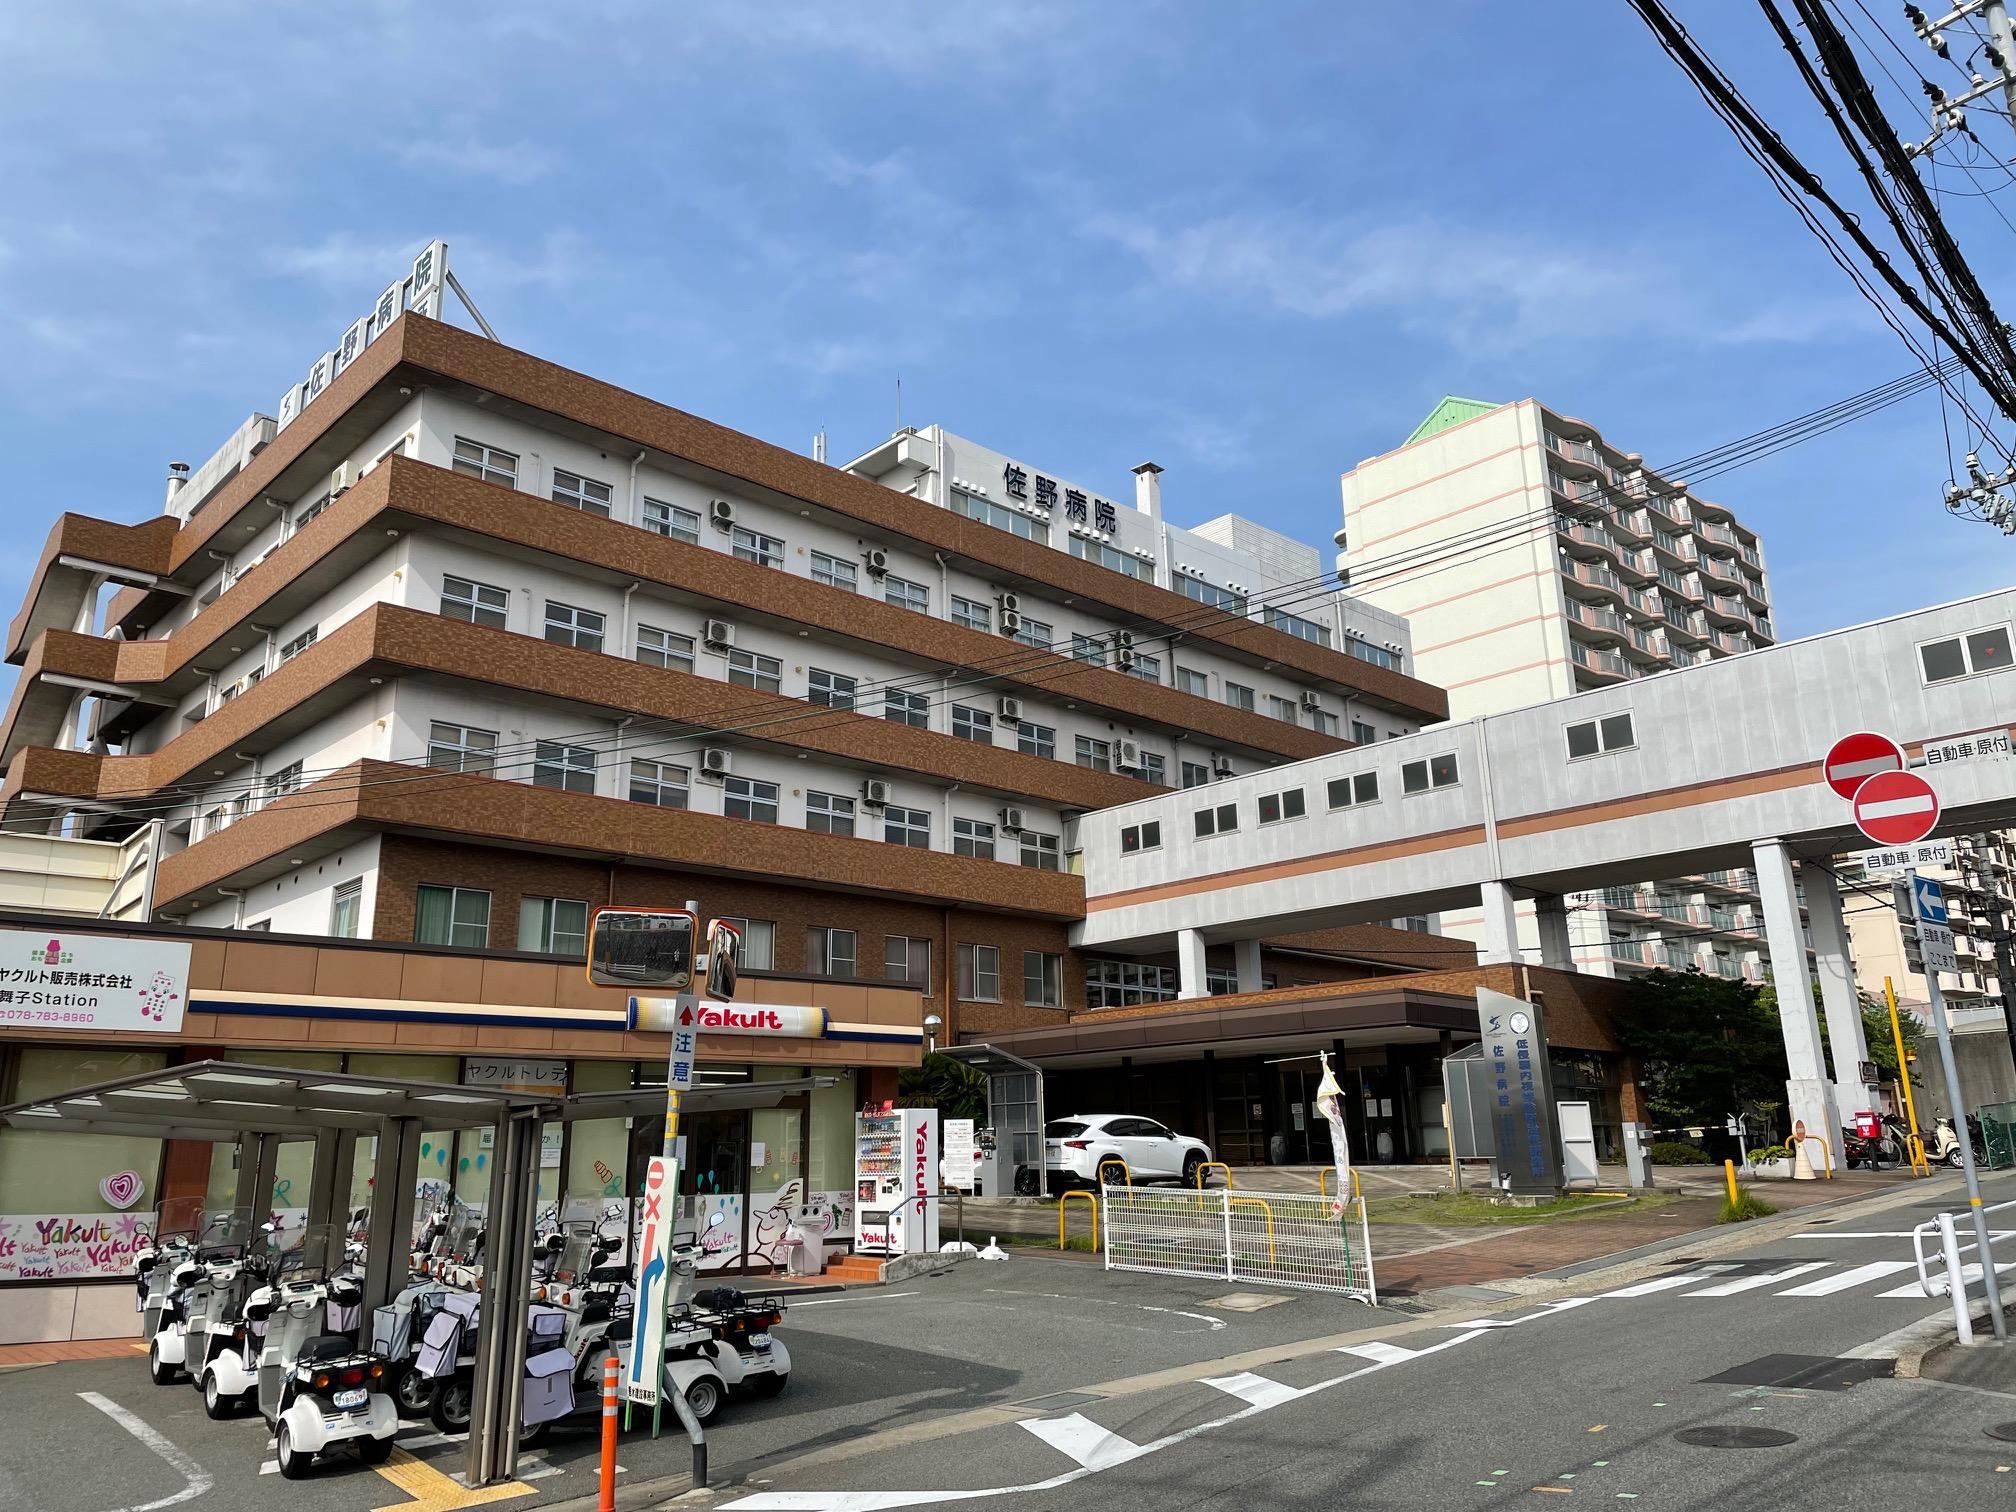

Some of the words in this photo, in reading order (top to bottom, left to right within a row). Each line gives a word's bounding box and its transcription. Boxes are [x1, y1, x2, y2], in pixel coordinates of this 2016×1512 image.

[310, 249, 433, 397] 佐野病院
[1003, 462, 1116, 534] 佐野病院
[1930, 952, 1955, 968] ここまで
[671, 1032, 693, 1083] 注意
[914, 1120, 929, 1215] Yakult
[36, 1218, 112, 1245] Yakult
[54, 1247, 81, 1259] Yakult
[87, 1234, 149, 1267] Yakult
[19, 1266, 55, 1278] Yakult
